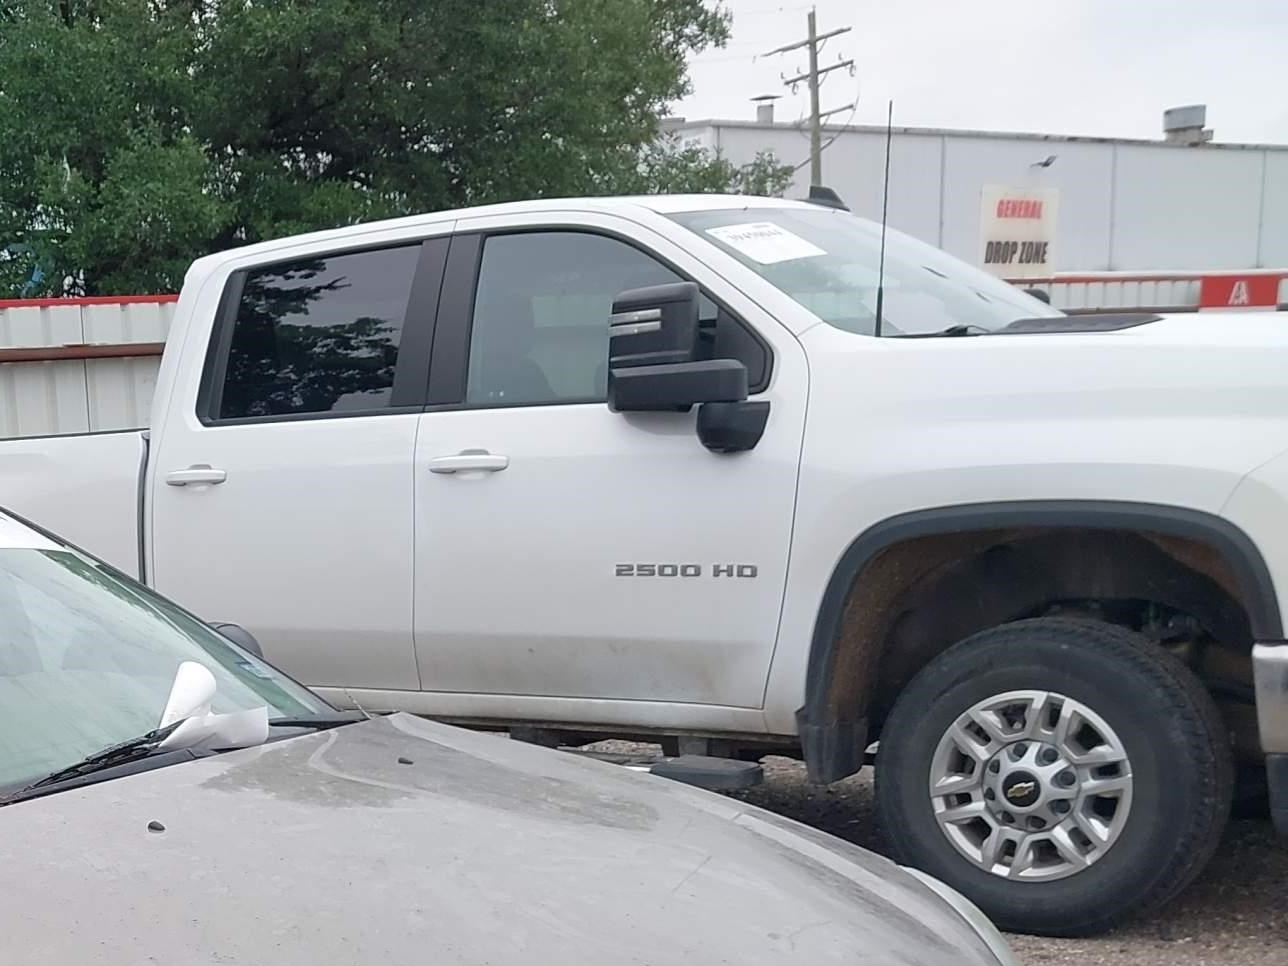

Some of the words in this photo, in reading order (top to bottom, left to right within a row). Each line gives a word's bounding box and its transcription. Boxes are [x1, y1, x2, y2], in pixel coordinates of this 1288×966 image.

[997, 199, 1043, 219] GENERAL
[984, 240, 1018, 264] DROP
[1018, 240, 1049, 264] ZONE
[615, 563, 702, 577] 2500
[712, 564, 758, 578] HD
